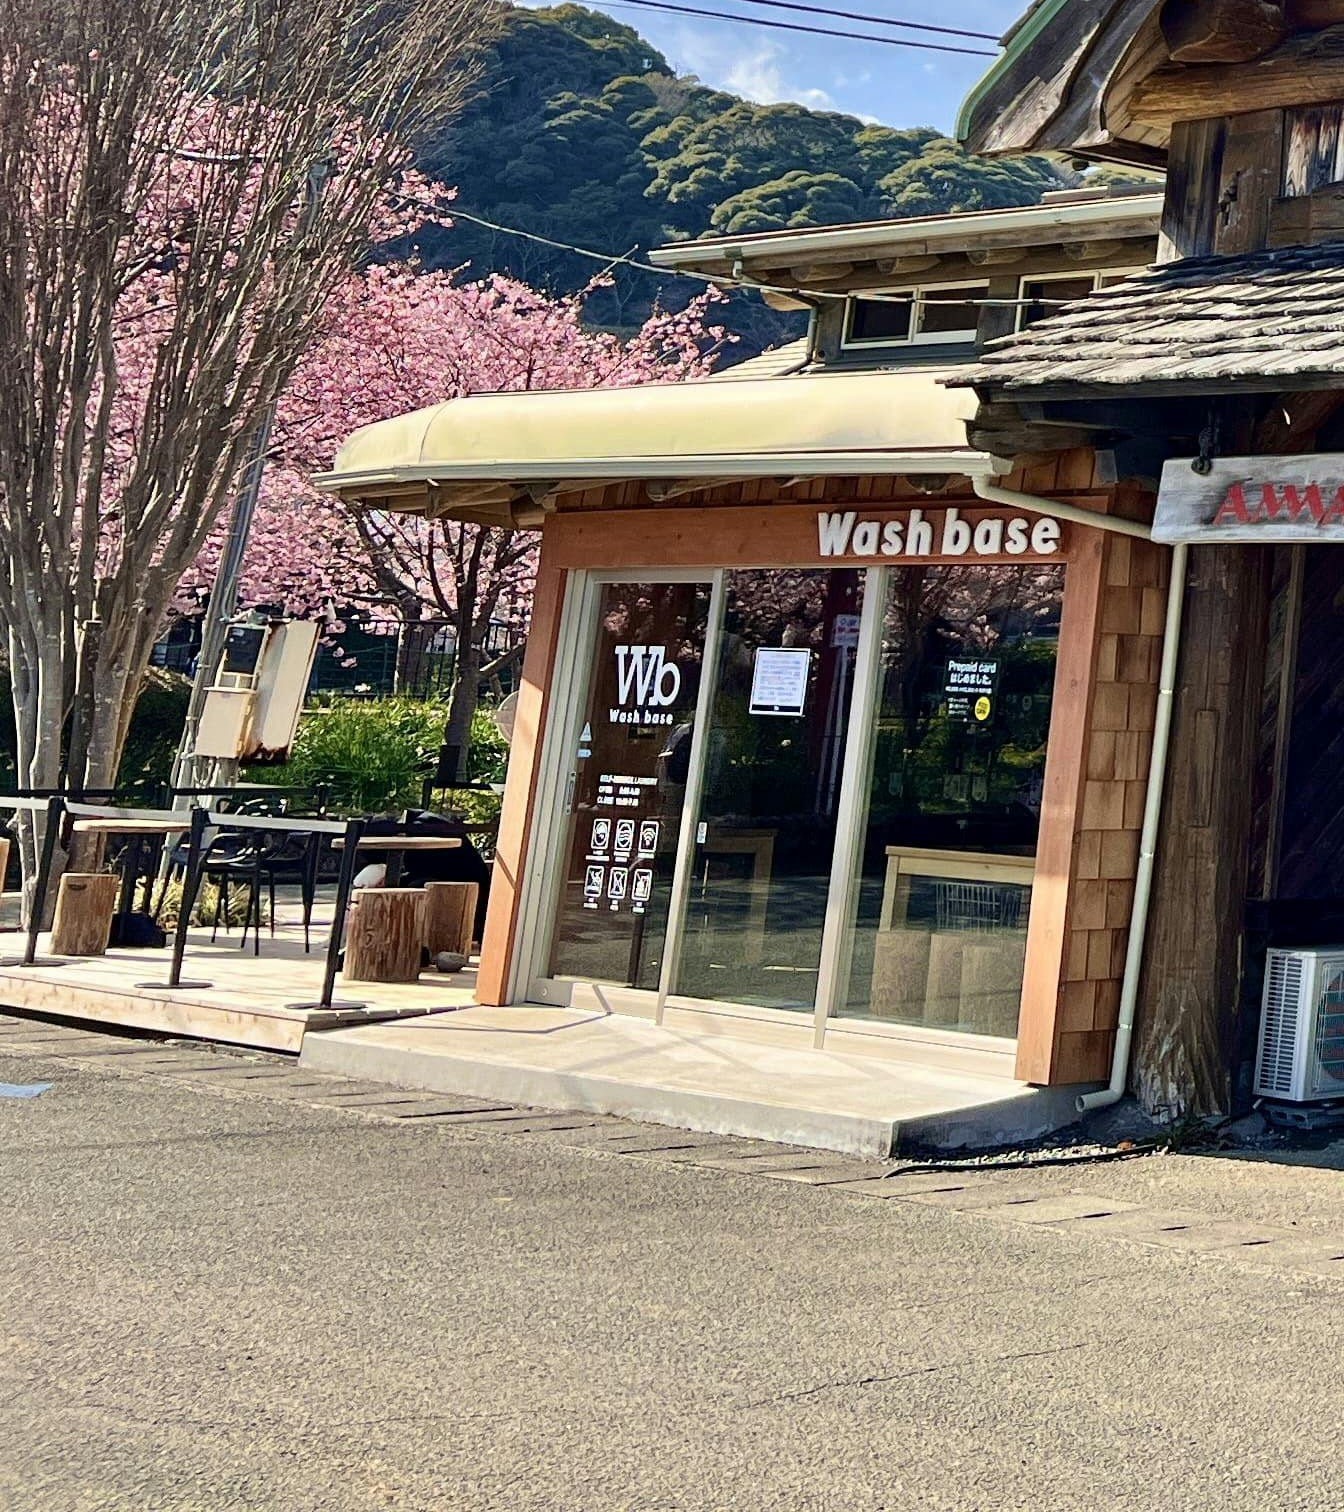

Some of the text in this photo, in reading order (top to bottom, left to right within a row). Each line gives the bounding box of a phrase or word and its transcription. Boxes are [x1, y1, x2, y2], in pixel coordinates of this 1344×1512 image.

[817, 507, 1061, 556] Wash base
[614, 645, 681, 706] Wb
[948, 660, 997, 674] Prepaid card
[609, 708, 674, 725] Wash base
